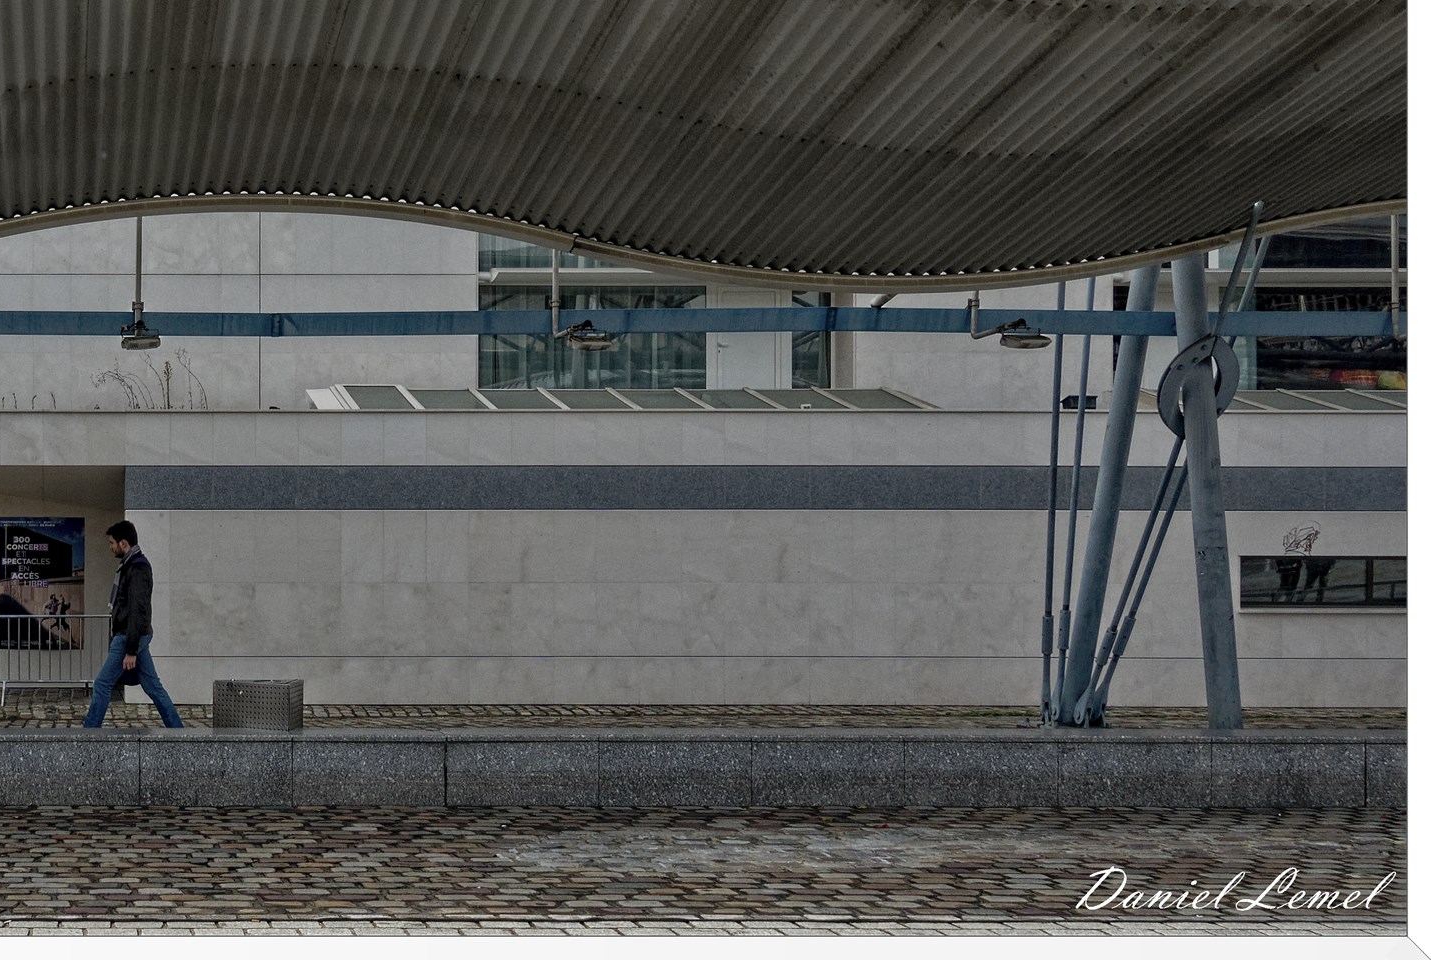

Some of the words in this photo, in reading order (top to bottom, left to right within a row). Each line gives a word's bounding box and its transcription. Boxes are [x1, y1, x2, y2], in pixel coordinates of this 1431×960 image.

[12, 536, 31, 544] 300
[6, 543, 49, 551] CONCERTS
[1, 558, 51, 566] SPECTACLES
[24, 580, 48, 588] LIBRE
